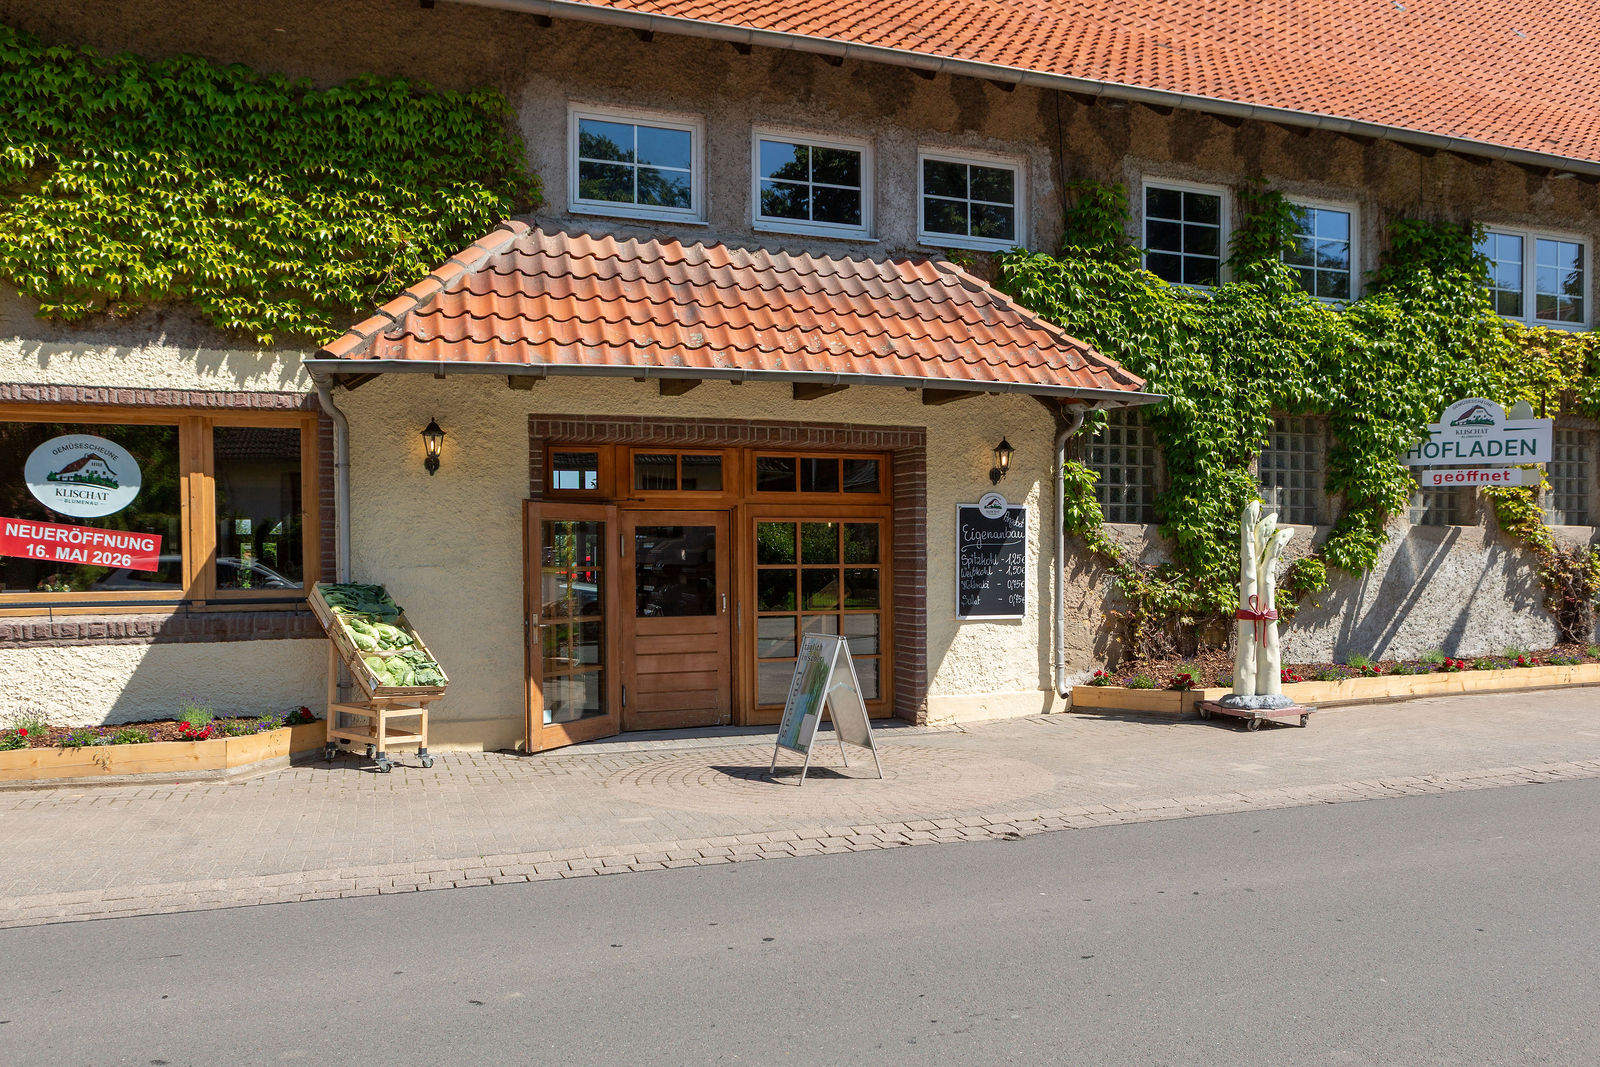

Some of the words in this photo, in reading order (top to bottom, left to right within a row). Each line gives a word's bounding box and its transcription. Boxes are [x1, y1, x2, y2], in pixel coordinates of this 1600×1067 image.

[1455, 428, 1490, 436] KLISCHAT
[52, 442, 119, 461] GEMÜSESCHEUNE
[1406, 439, 1537, 459] HOFLADEN
[1433, 470, 1510, 485] geöffnet
[55, 487, 110, 501] KLISCHAT
[63, 498, 99, 507] BLUMENAU
[5, 522, 155, 552] NEUERÖFFNUNG
[962, 524, 1025, 549] Eigenanbau
[26, 543, 50, 558] 16.
[55, 546, 88, 562] MAI
[91, 550, 132, 567] 2026
[961, 552, 999, 569] Spitzkohl
